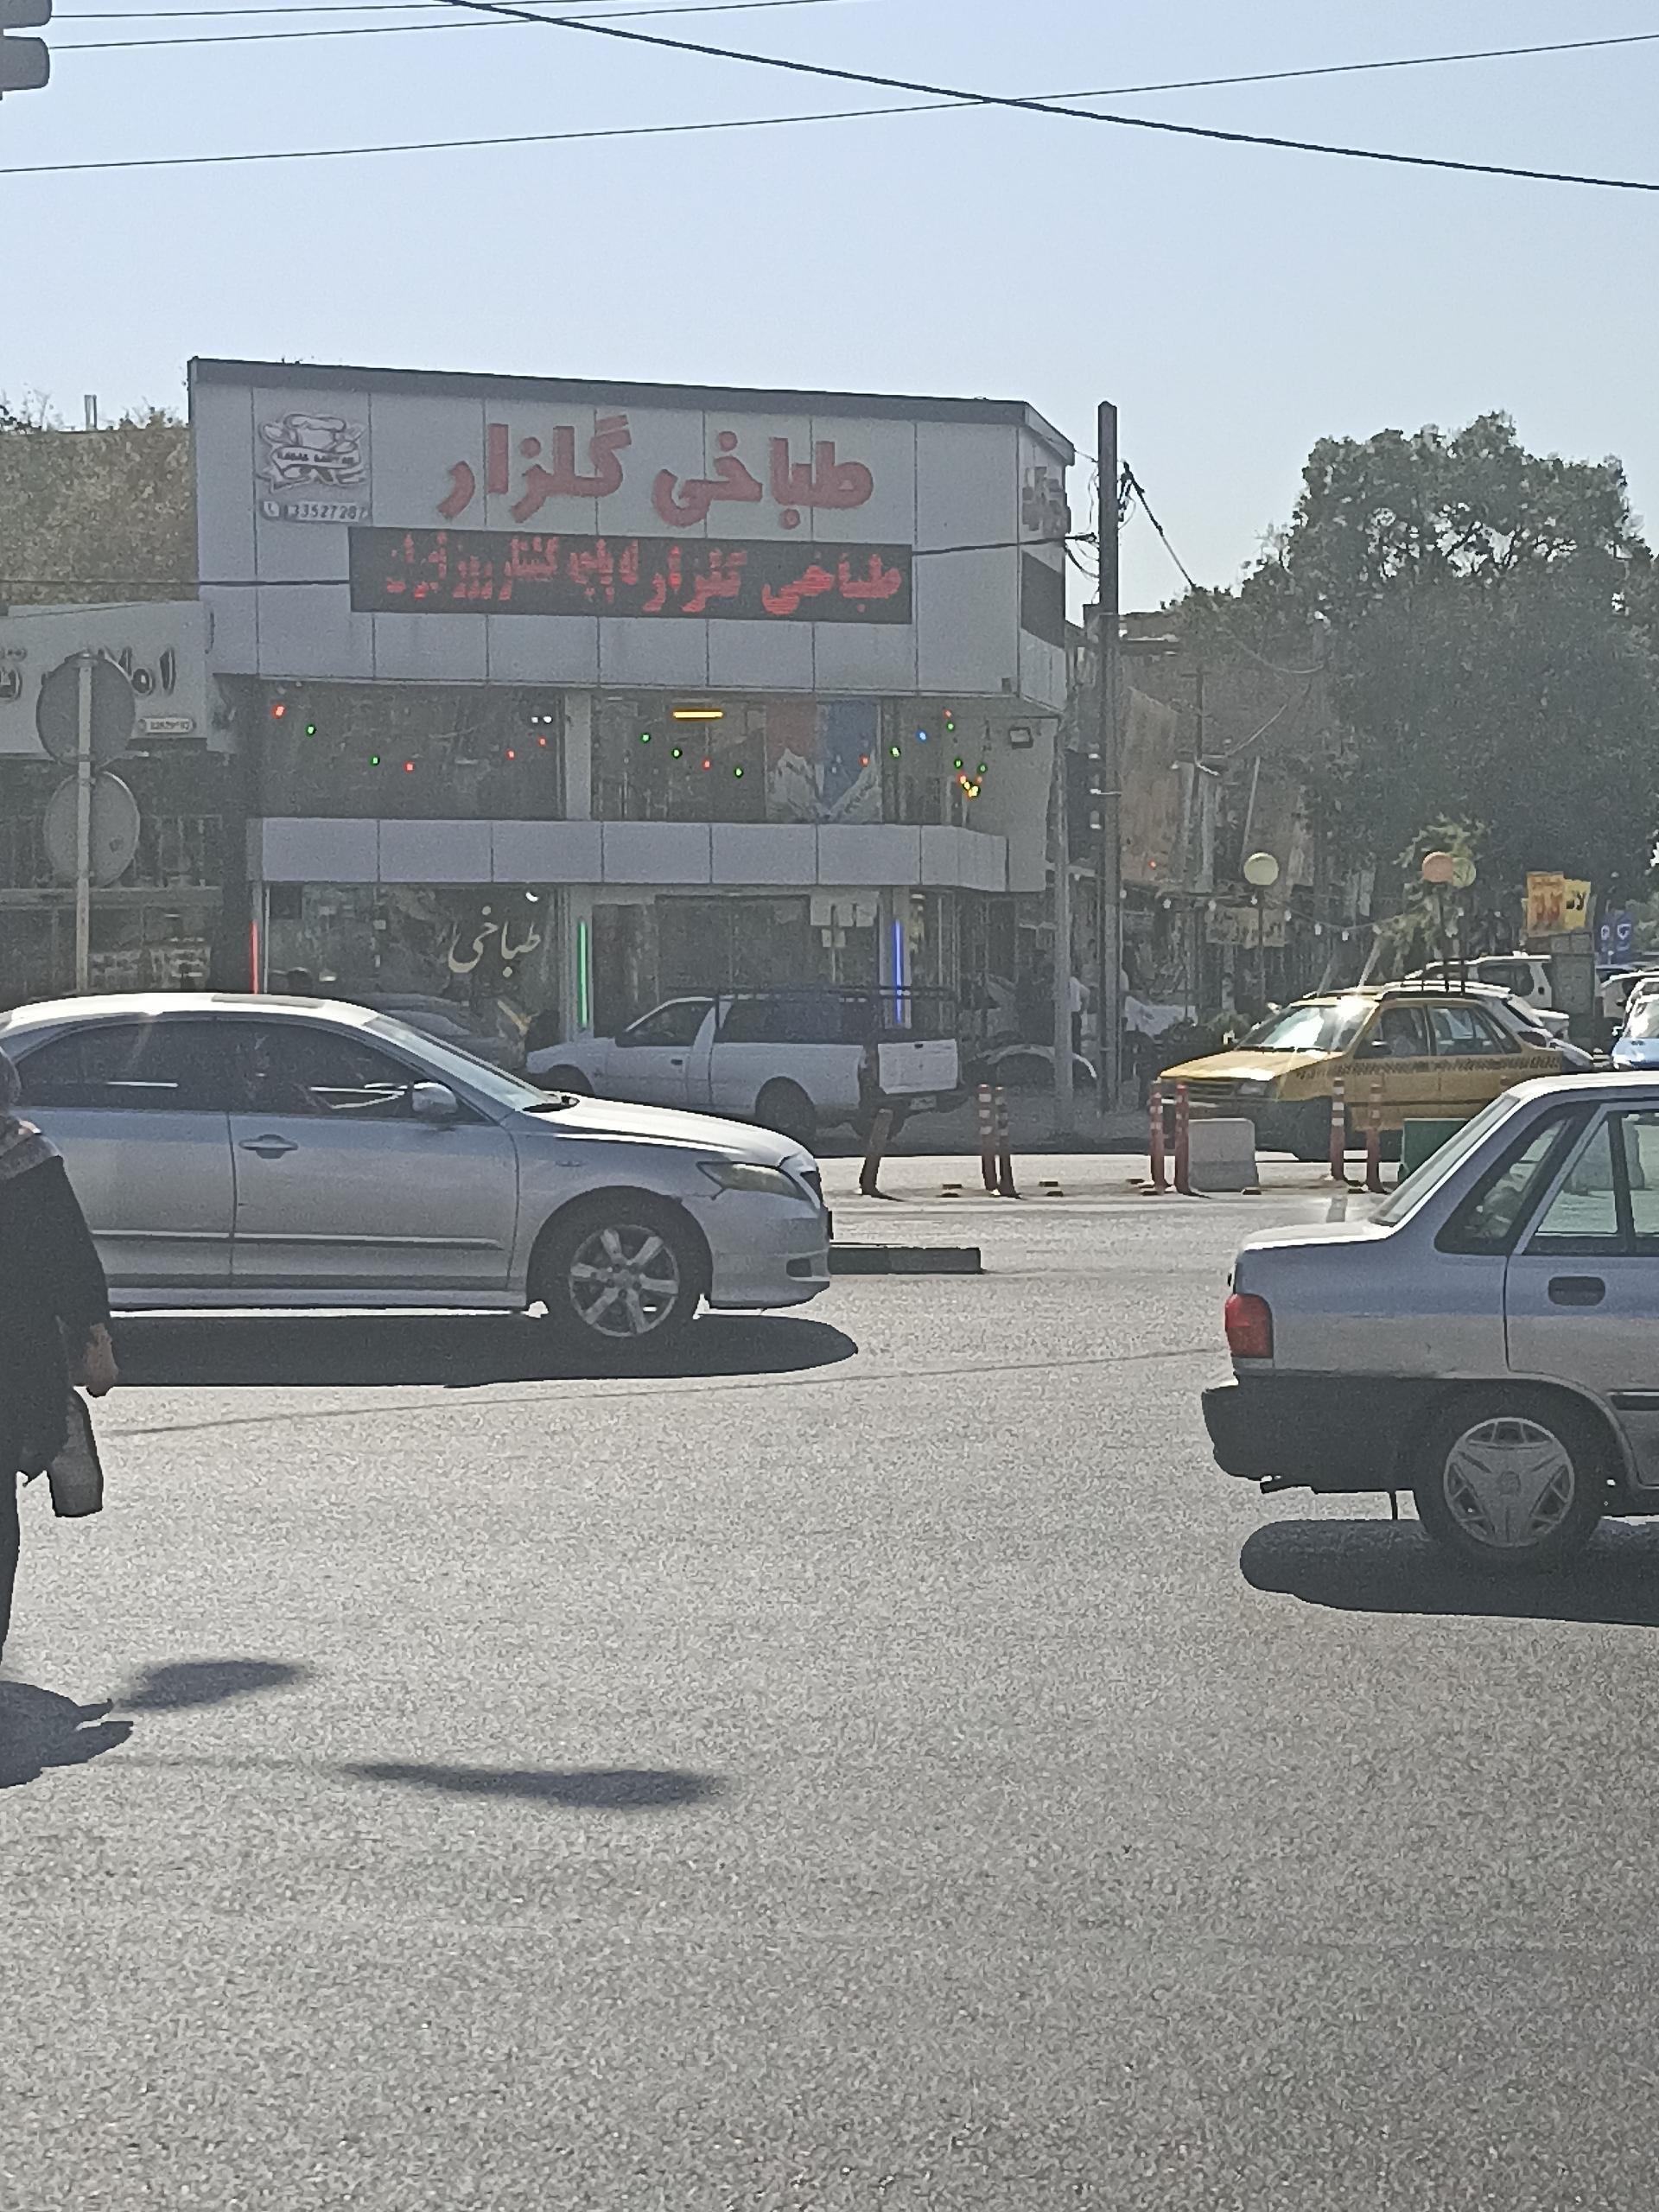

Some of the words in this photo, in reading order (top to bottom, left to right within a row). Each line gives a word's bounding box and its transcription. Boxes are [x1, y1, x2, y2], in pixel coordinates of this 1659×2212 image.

[436, 414, 633, 524] گلزار
[652, 430, 874, 530] طباخی
[448, 906, 542, 978] طباخی
